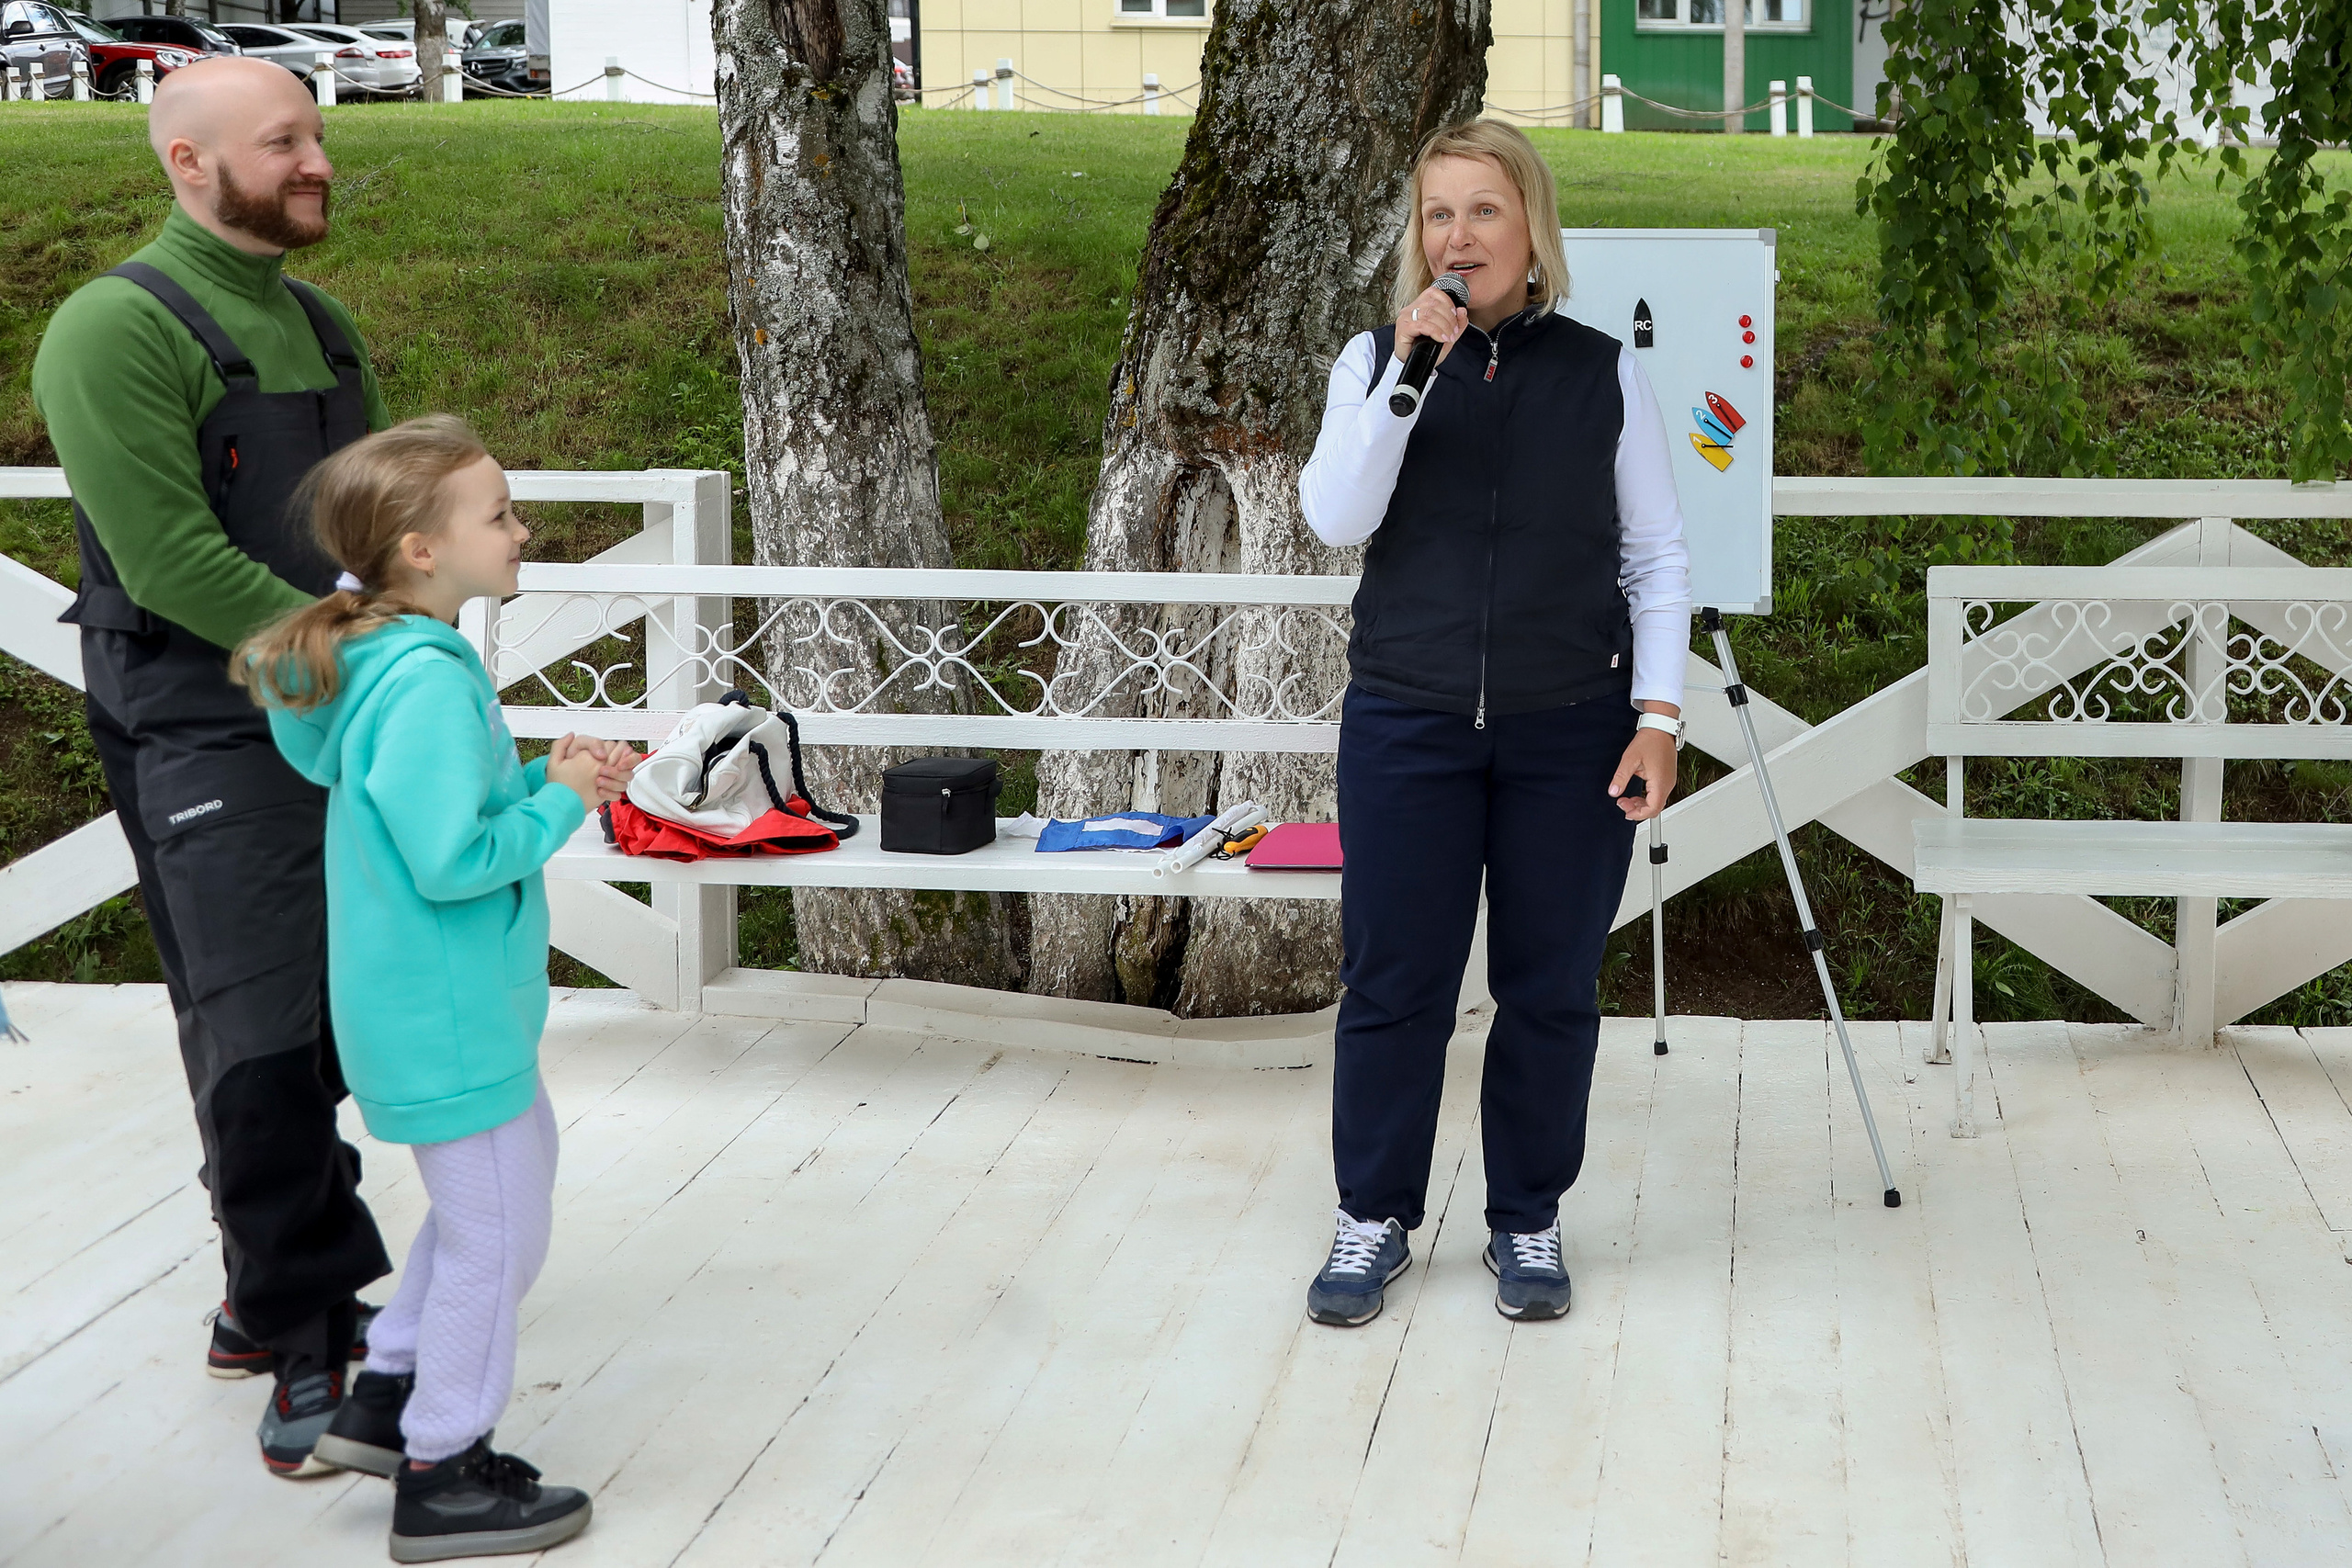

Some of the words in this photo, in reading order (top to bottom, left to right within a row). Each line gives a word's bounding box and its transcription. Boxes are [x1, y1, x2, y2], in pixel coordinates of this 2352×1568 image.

[1634, 320, 1652, 331] RC
[1708, 394, 1718, 404] 3
[1695, 410, 1706, 420] 2
[1692, 435, 1702, 444] 1
[168, 799, 223, 826] TRIBORD
